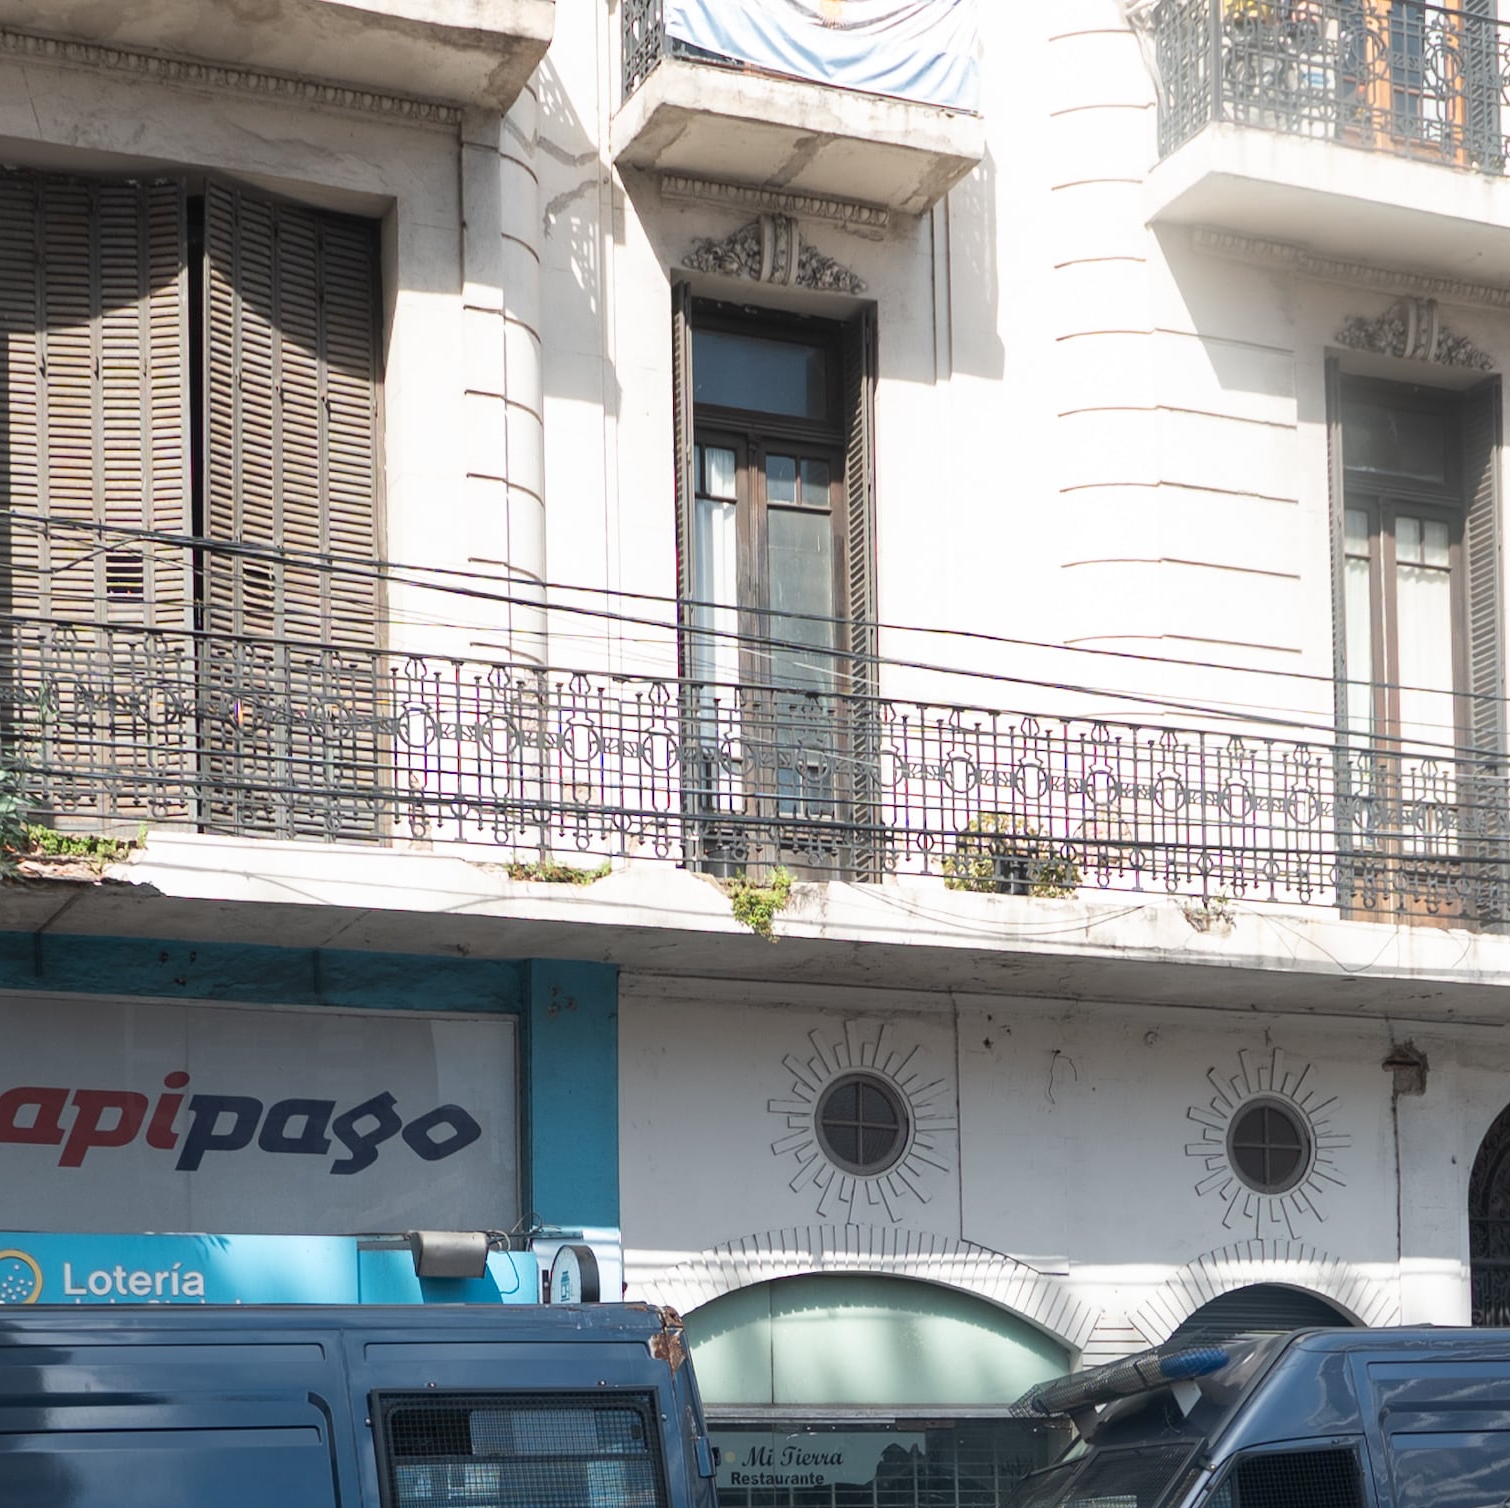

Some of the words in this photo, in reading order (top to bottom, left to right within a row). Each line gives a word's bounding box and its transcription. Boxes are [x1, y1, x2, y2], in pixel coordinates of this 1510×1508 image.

[63, 1262, 205, 1296] Lotería
[742, 1446, 774, 1467] Mi
[780, 1446, 843, 1467] Tierra
[731, 1471, 825, 1486] Restaurante
